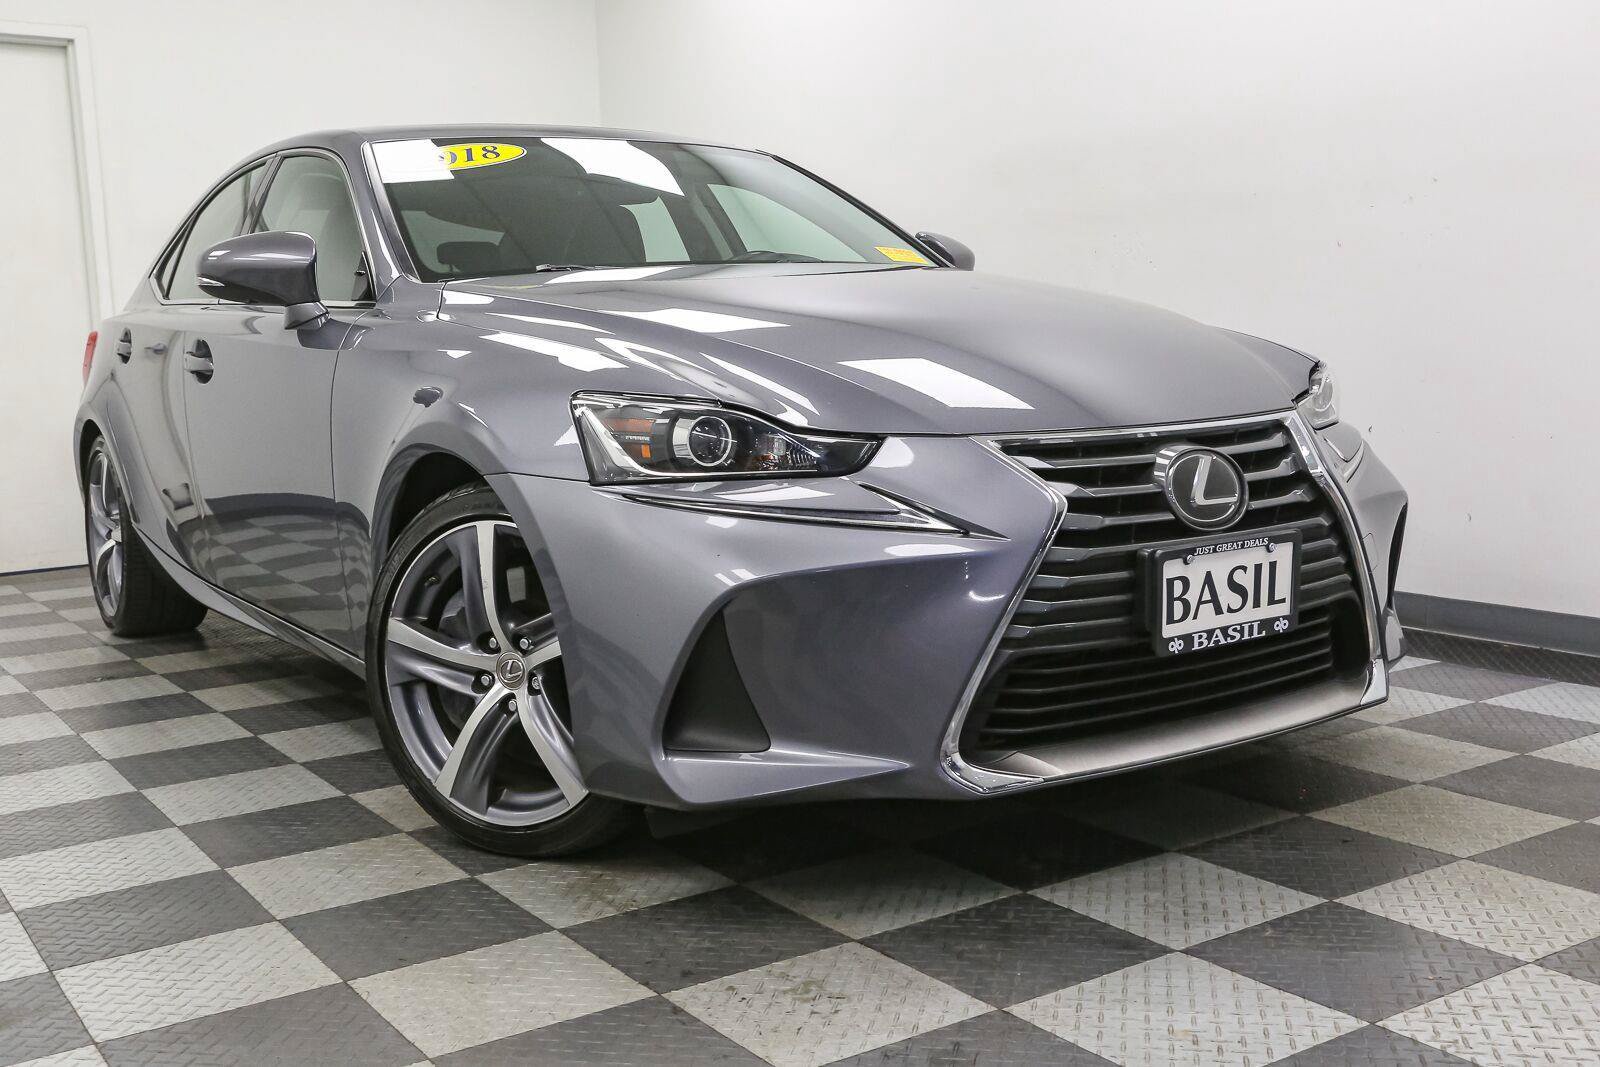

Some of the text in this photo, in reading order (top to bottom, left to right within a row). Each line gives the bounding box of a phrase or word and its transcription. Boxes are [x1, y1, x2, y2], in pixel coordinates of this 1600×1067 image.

[1194, 537, 1269, 556] JUST GREAT DEALS
[1165, 560, 1287, 626] BASIL
[1191, 621, 1266, 651] BASIL
